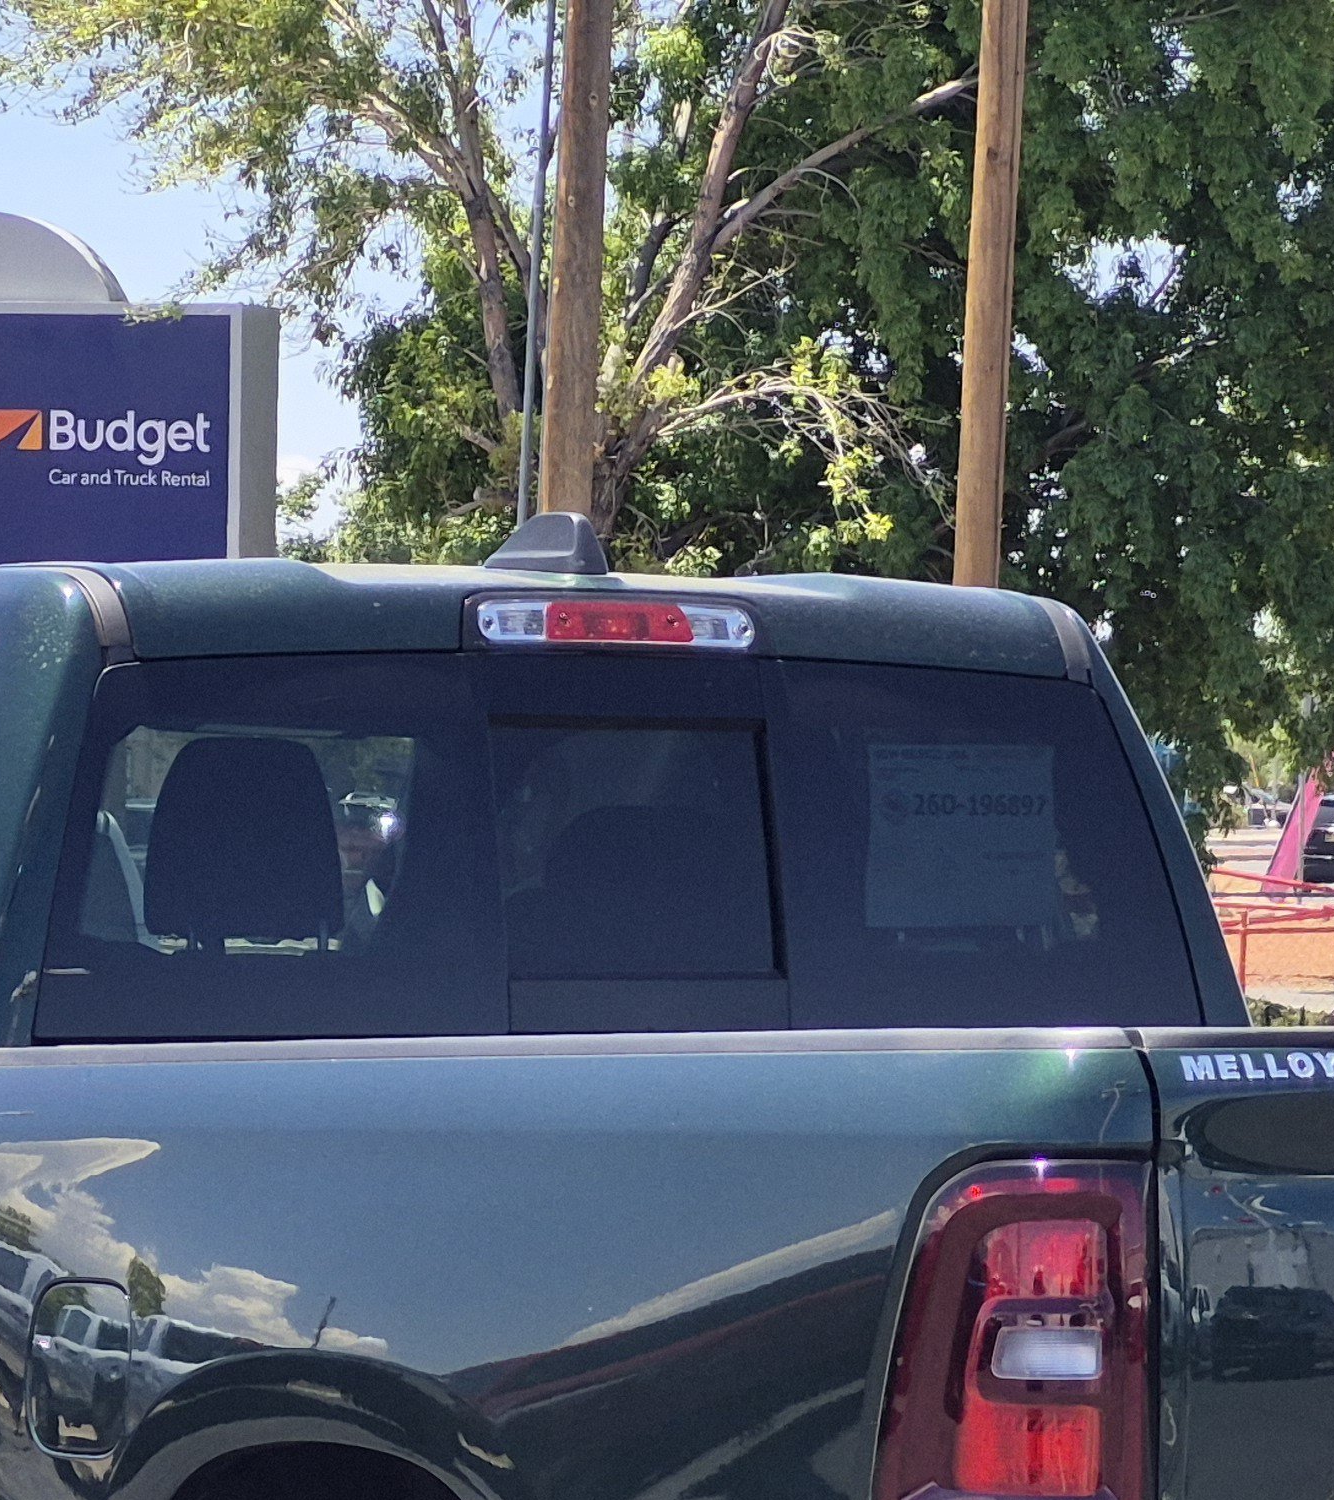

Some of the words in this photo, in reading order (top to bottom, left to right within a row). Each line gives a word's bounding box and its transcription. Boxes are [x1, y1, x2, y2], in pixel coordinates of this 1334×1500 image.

[49, 409, 211, 466] Budget
[48, 468, 78, 486] Car
[80, 469, 112, 486] and
[114, 468, 158, 487] Truck
[161, 470, 211, 488] Rental
